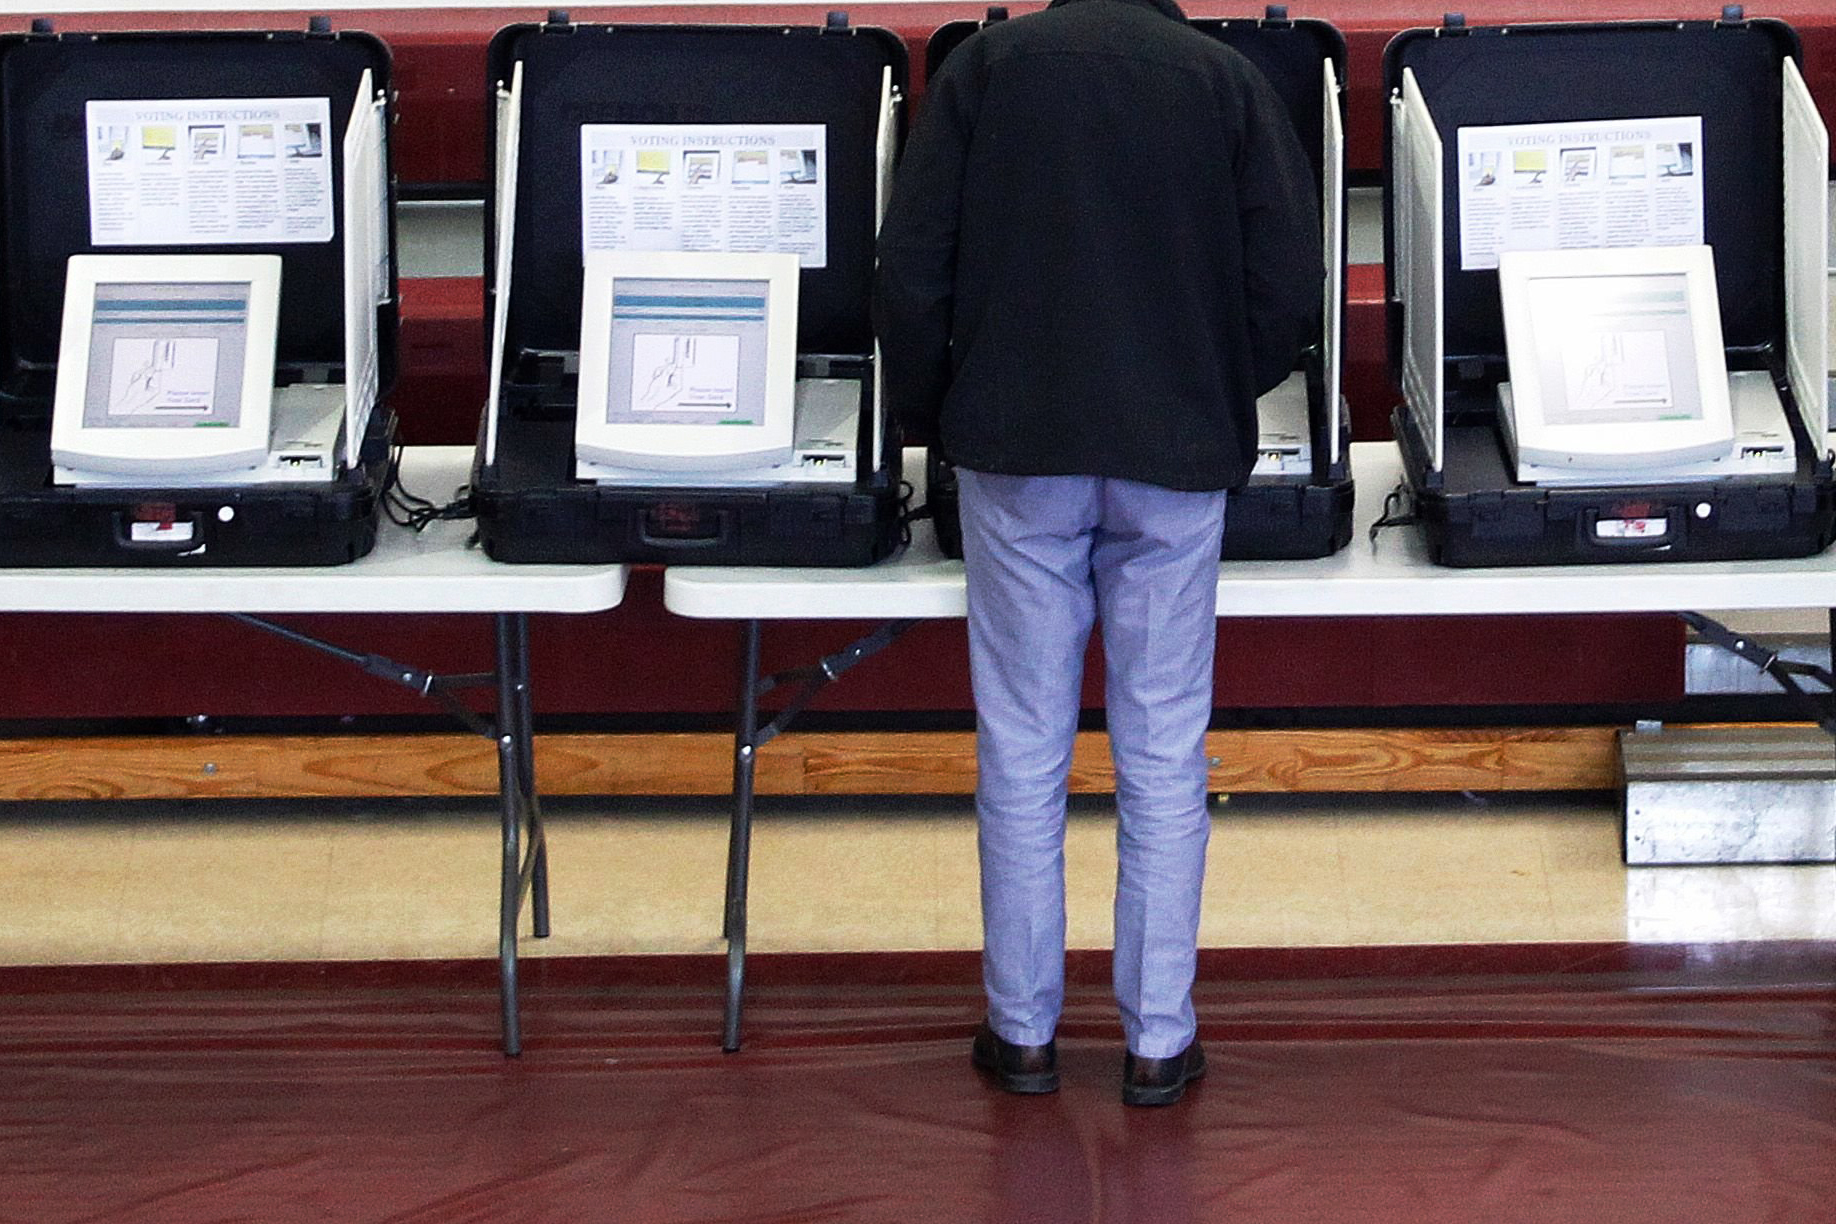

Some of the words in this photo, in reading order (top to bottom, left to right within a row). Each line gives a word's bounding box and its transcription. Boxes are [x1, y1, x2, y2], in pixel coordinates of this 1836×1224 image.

[135, 111, 183, 121] VOTING
[187, 110, 280, 120] INSTRUCTIONS
[630, 135, 678, 146] VOTING
[683, 135, 776, 147] INSTRUCTIONS
[1508, 134, 1556, 146] VOTING
[1559, 130, 1651, 145] INSTRUCTIONS
